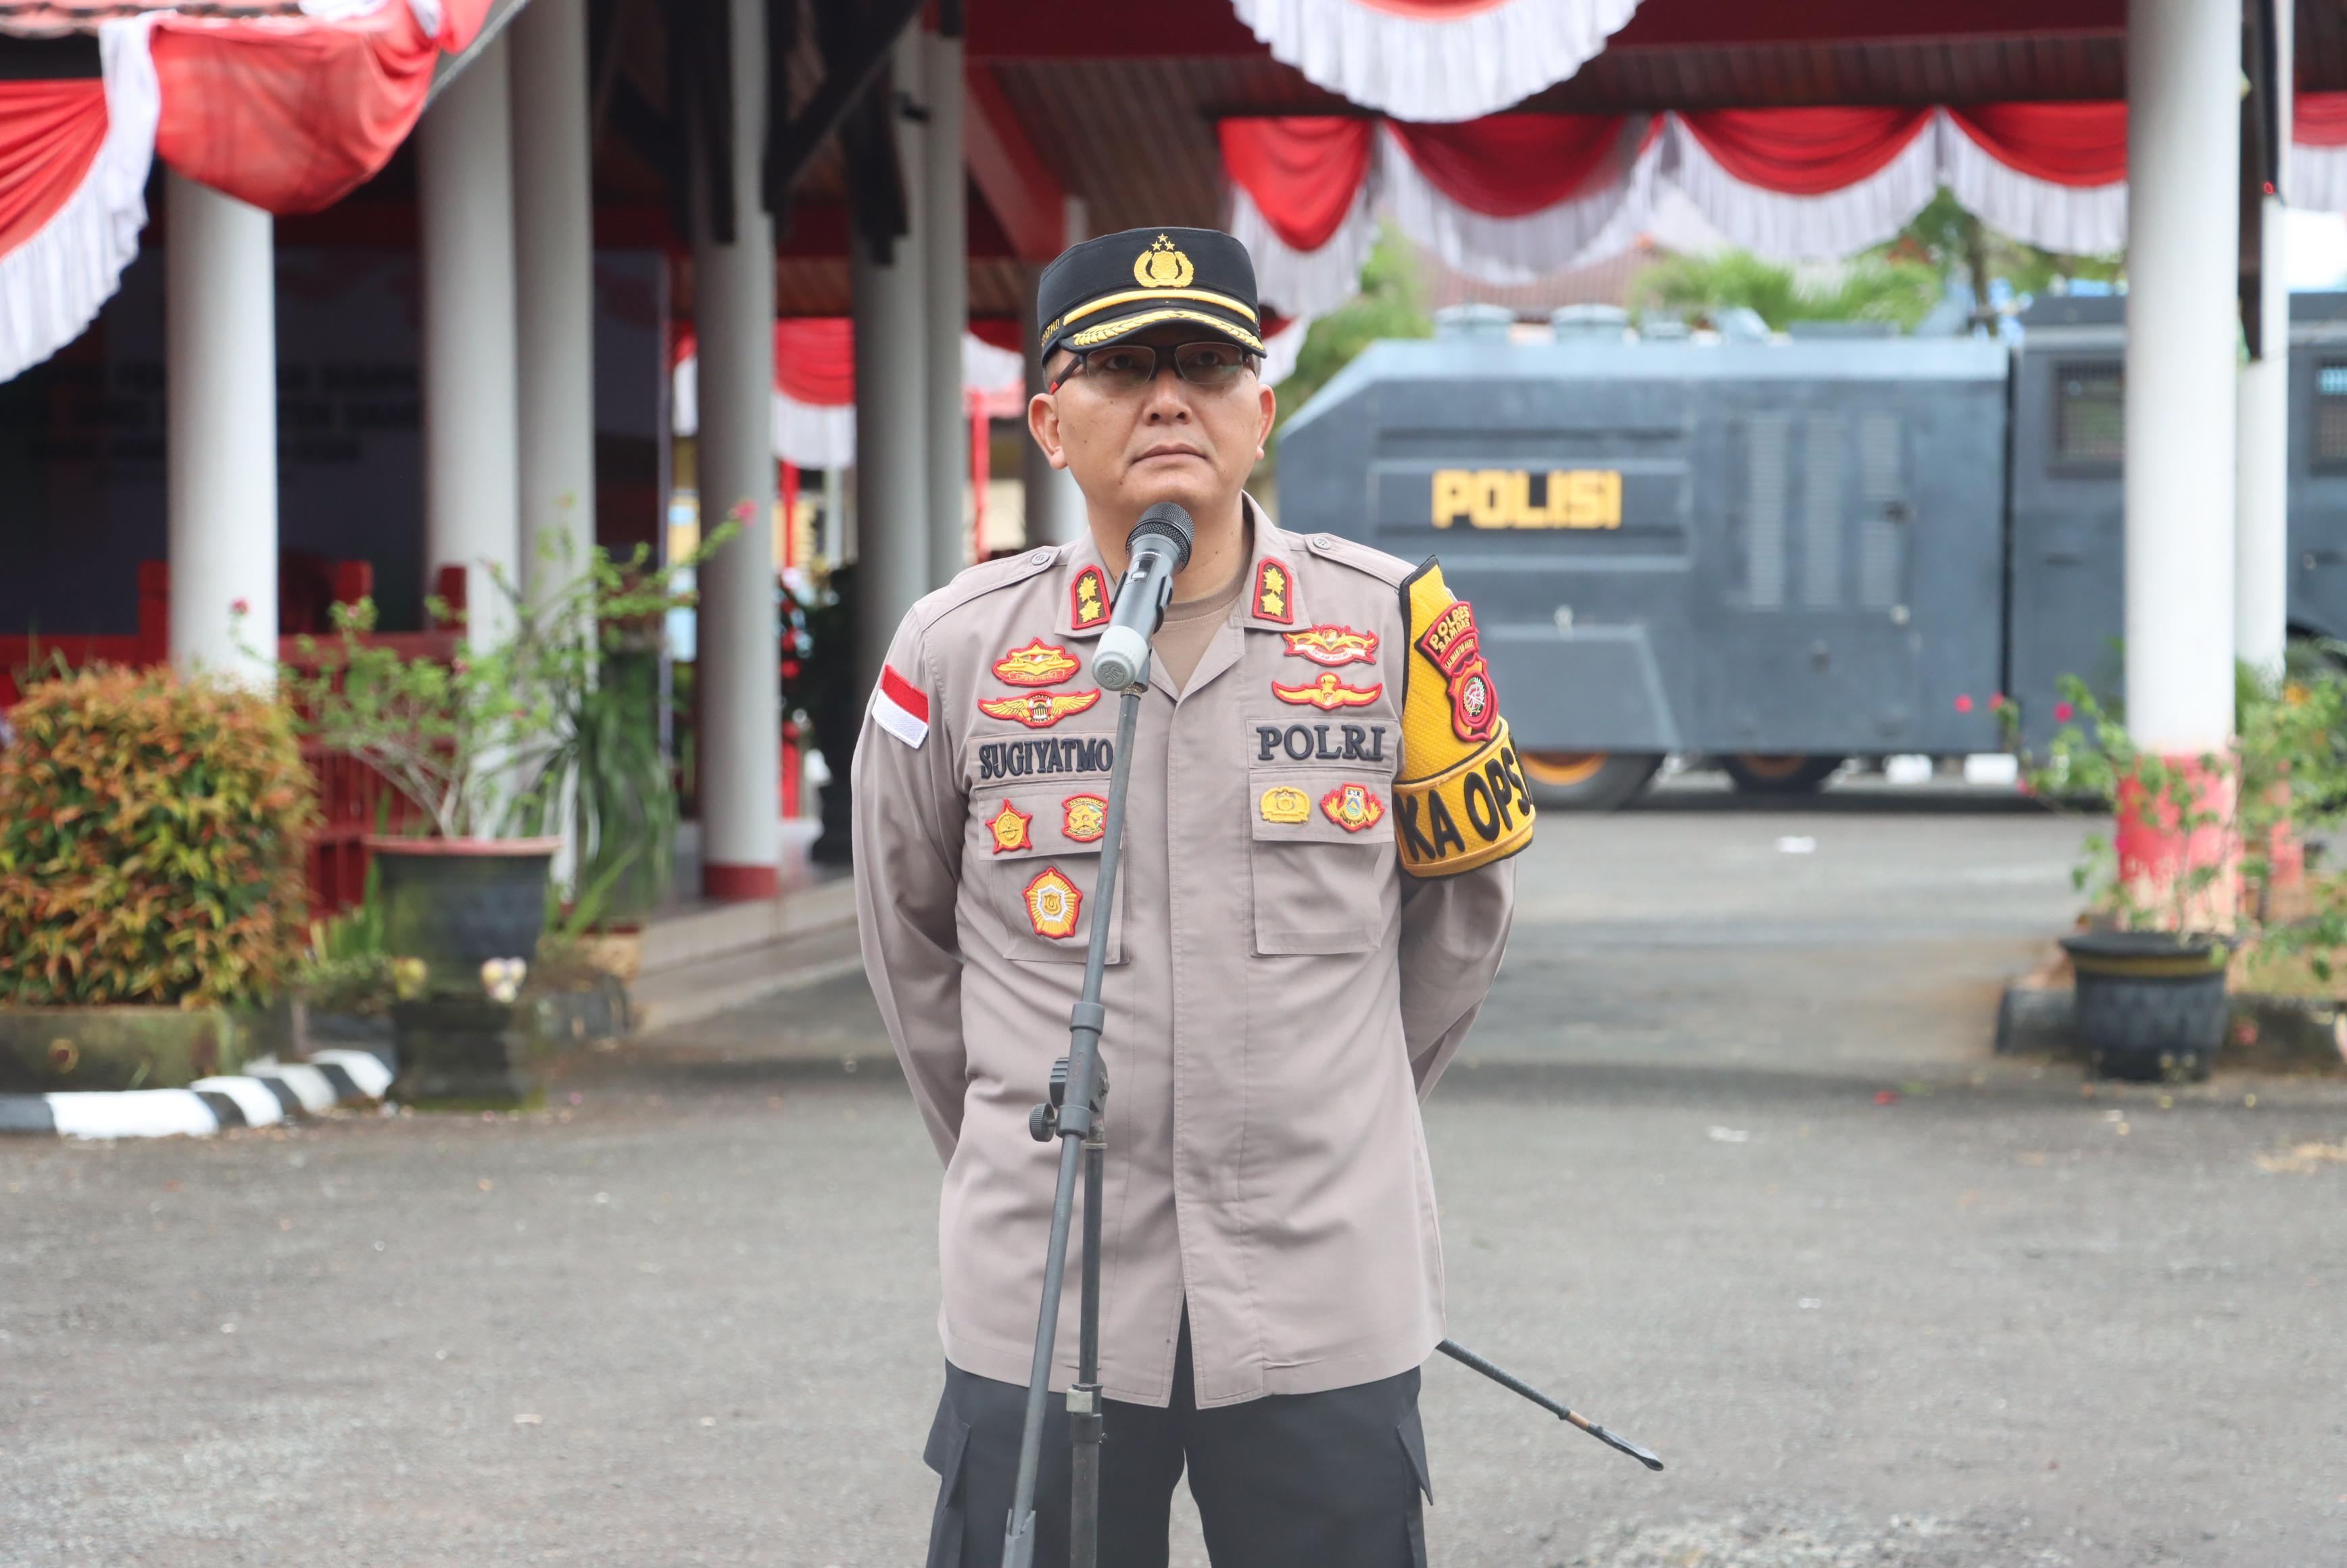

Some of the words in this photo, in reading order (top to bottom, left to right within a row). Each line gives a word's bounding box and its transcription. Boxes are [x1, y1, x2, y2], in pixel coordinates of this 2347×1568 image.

[1432, 468, 1622, 529] POLISI
[1429, 606, 1470, 650] POLRES
[1437, 618, 1470, 654] SAMBAS
[979, 737, 1114, 779] SUGIYATMO
[1256, 725, 1386, 761] POLRI
[1393, 789, 1466, 862] KA
[1463, 735, 1532, 841] OPS
